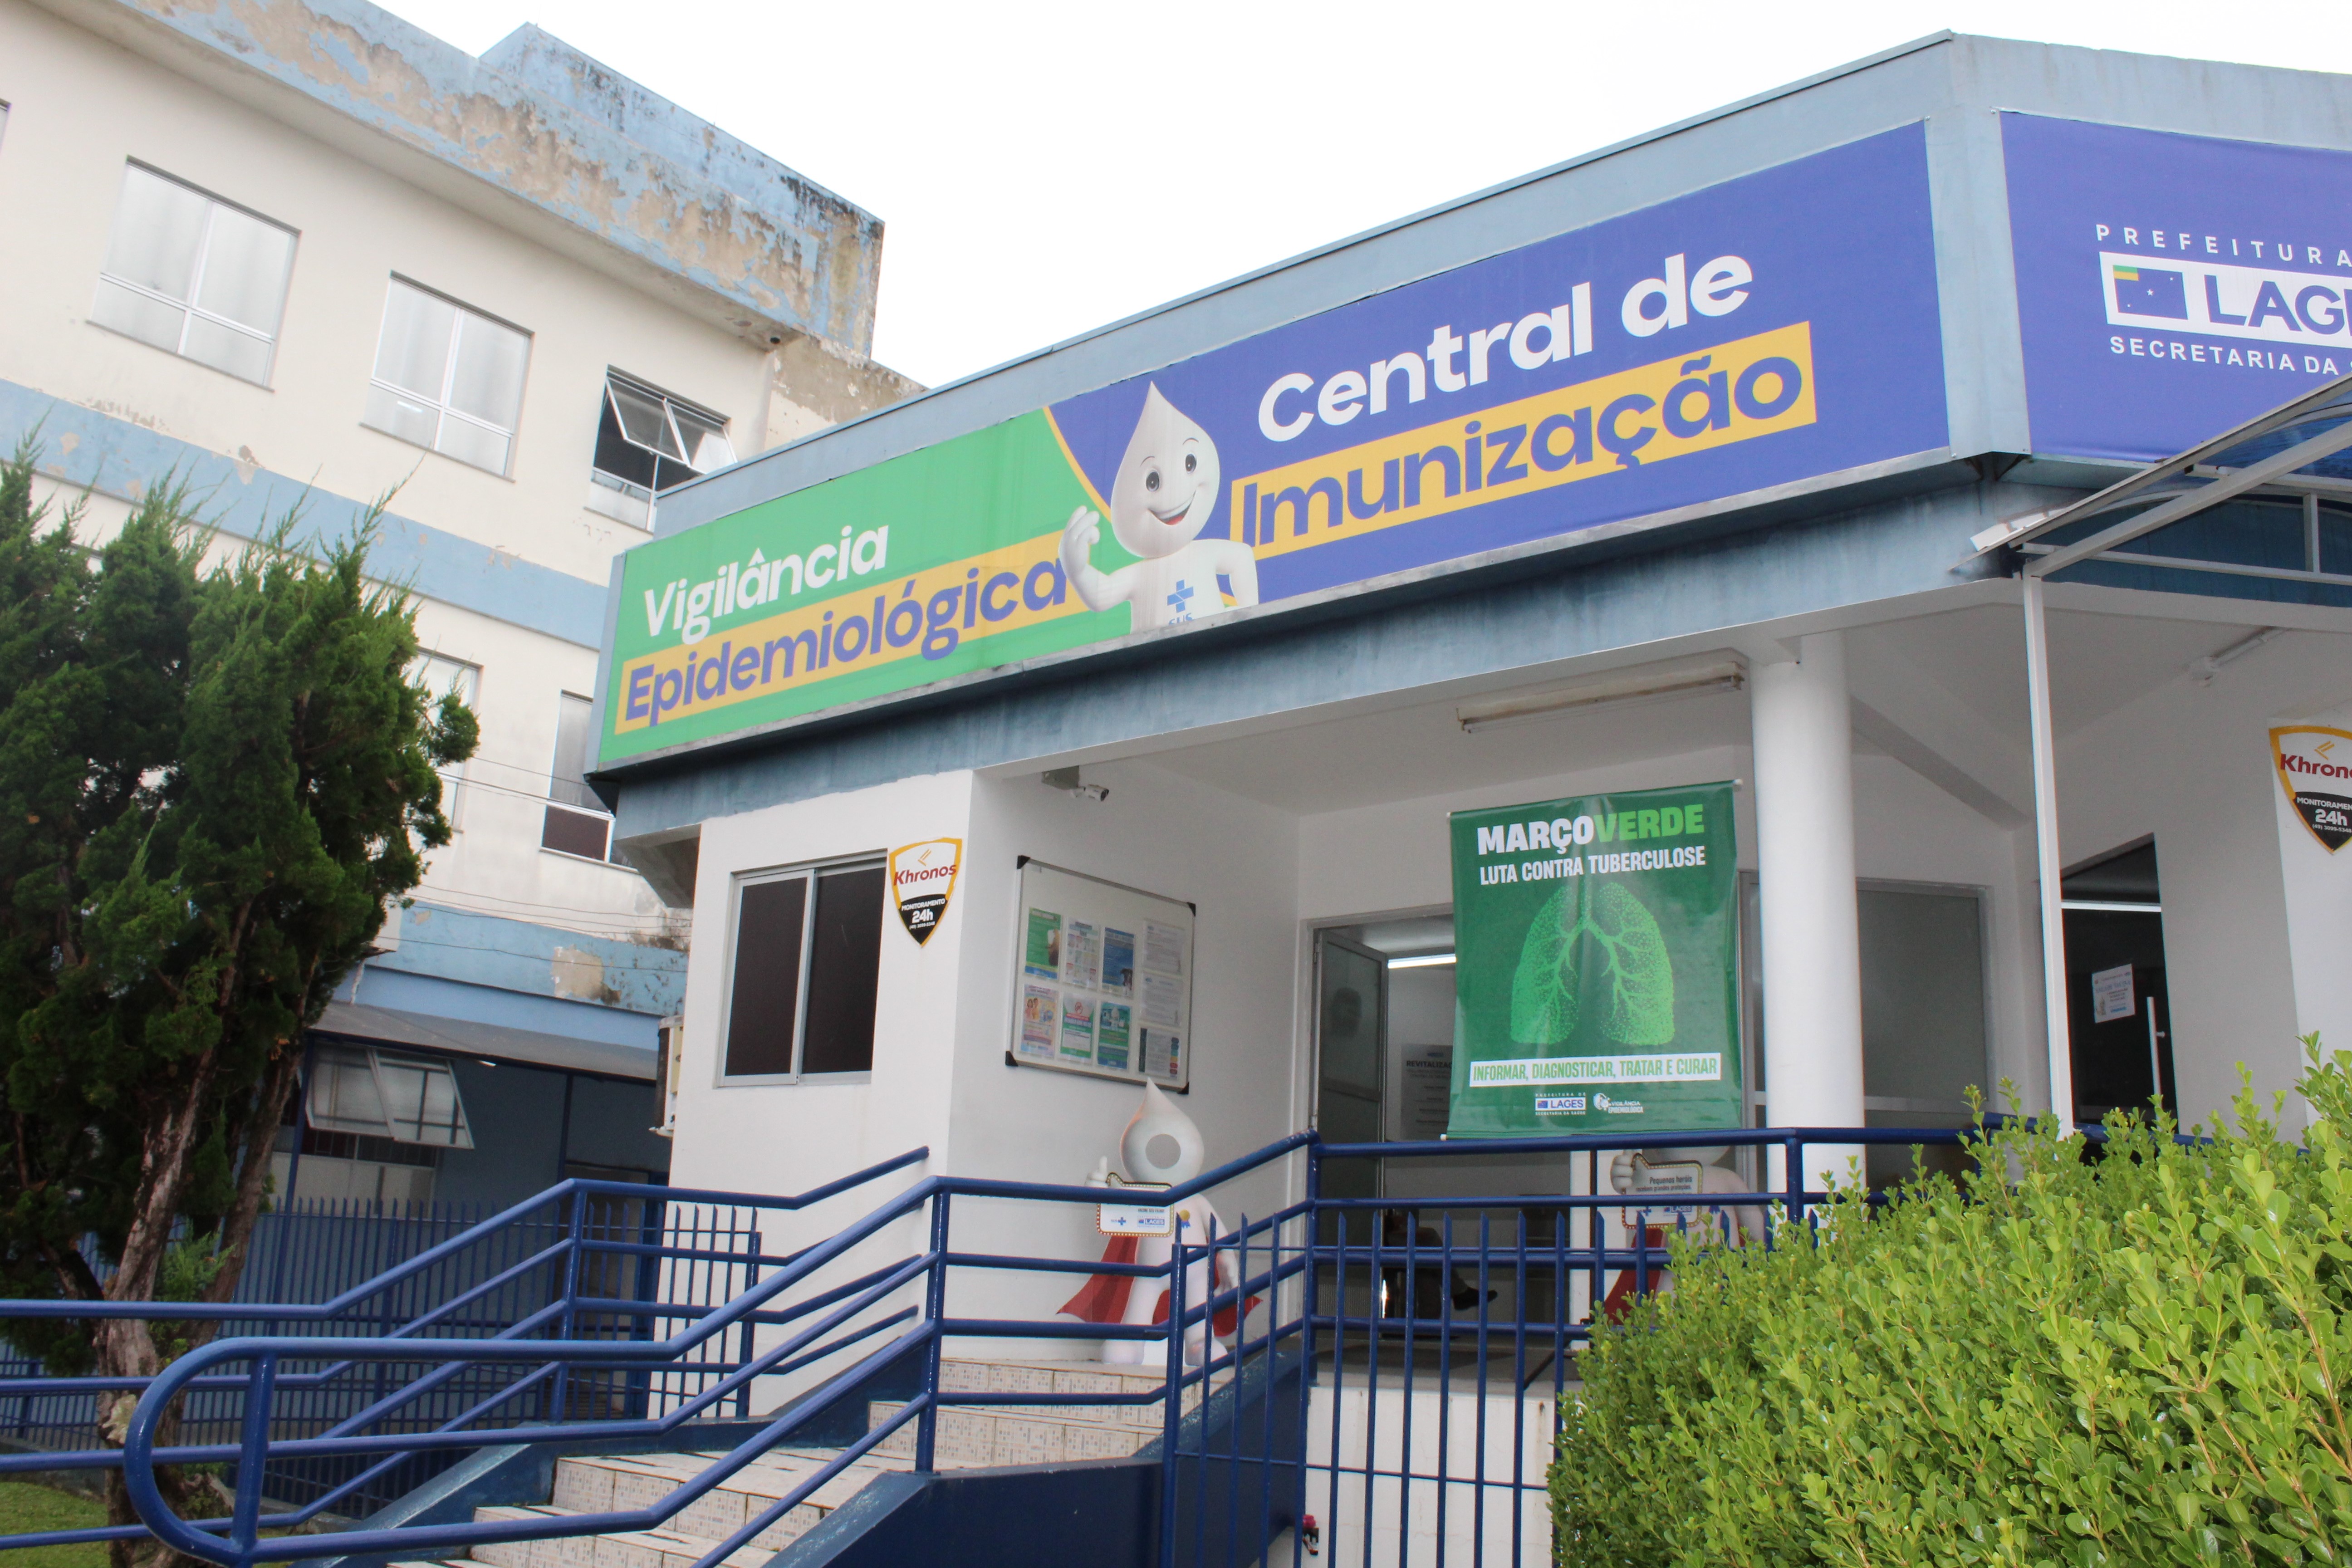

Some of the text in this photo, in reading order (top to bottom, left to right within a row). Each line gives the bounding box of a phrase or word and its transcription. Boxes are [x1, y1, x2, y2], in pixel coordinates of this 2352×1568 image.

[2096, 224, 2352, 267] PREFEITURA
[1258, 253, 1753, 442] Central de
[2110, 336, 2296, 372] SECRETARIA
[2304, 356, 2339, 376] DA
[1242, 355, 1803, 548] Imunização
[644, 524, 889, 645] Vigilância
[624, 556, 1068, 726] Epidemiológica
[2315, 808, 2347, 826] 24h
[893, 864, 957, 886] Khronos
[1480, 845, 1706, 885] LUTA CONTRA TUBERCULOSE
[901, 898, 946, 911] MONITORAMENTO
[911, 908, 934, 924] 24h
[1473, 1058, 1717, 1082] INFORMAR, DIAGNOSTICAR, TRATAR E CURAR
[1550, 1099, 1584, 1108] LAGES
